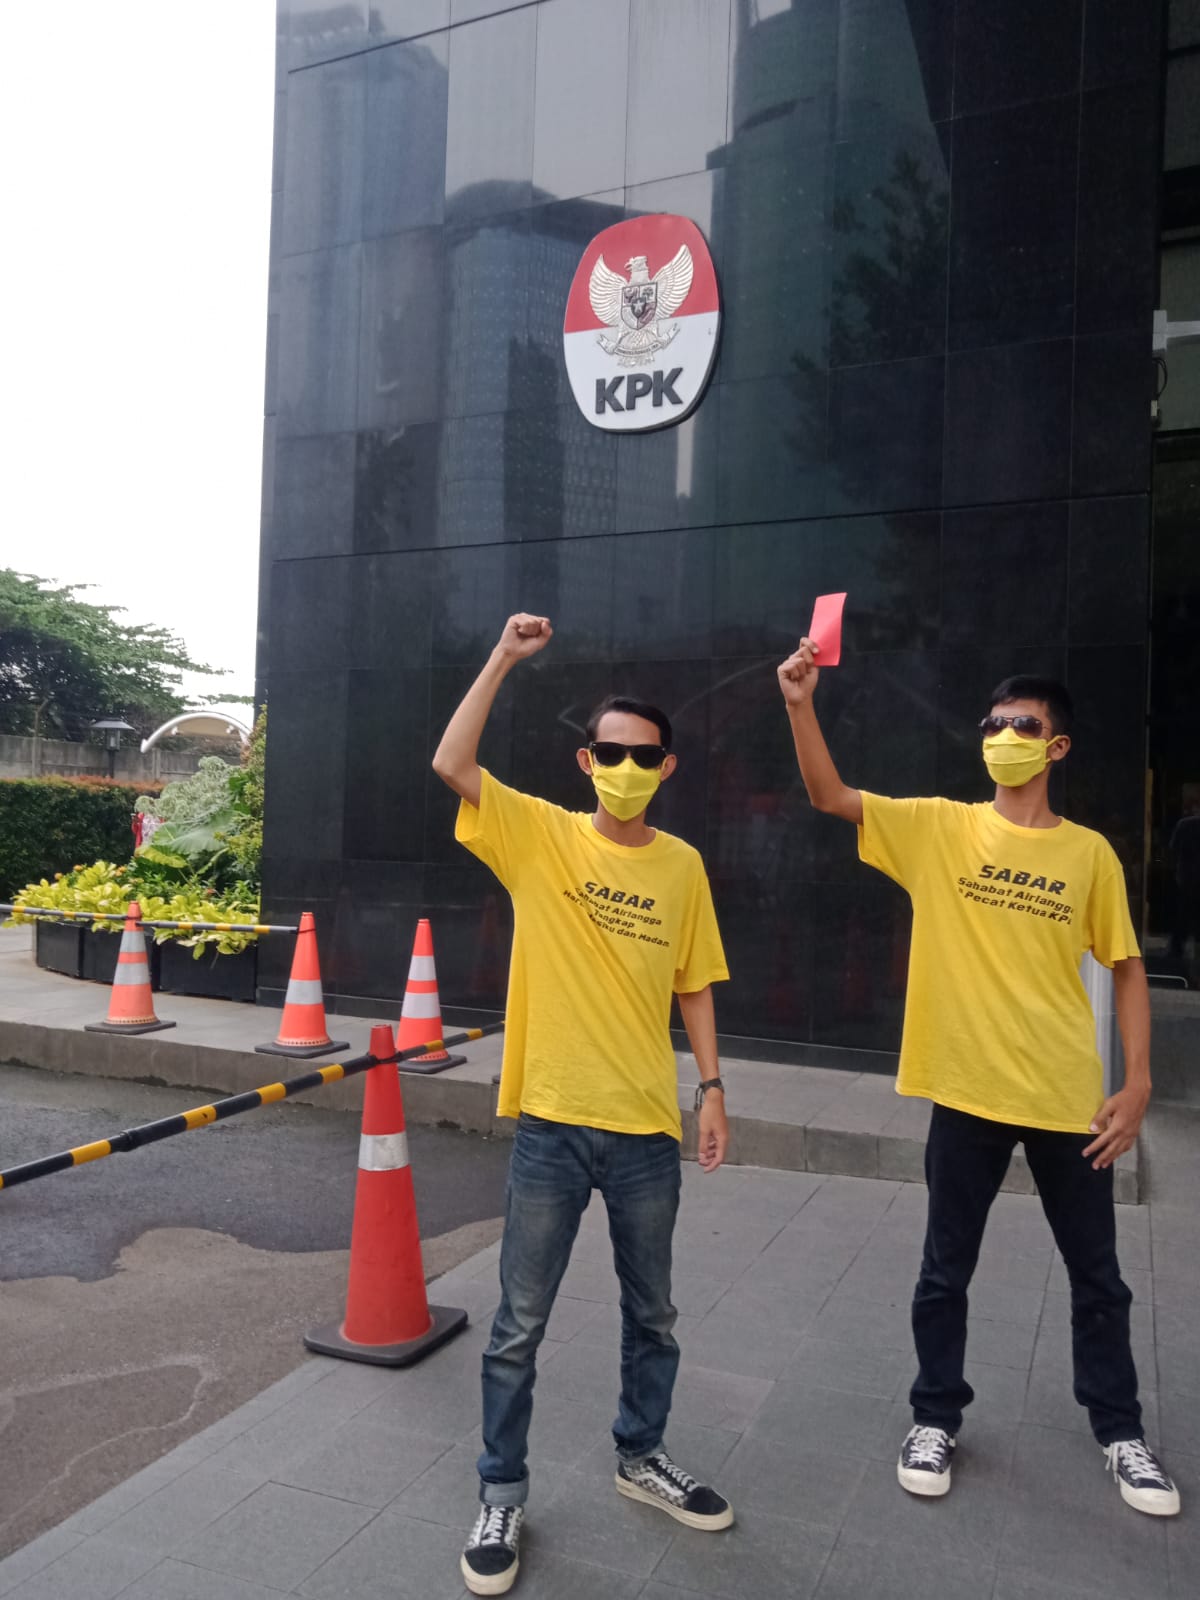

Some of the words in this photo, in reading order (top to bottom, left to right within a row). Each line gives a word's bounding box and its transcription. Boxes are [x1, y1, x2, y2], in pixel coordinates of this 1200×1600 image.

[596, 367, 683, 414] KPK
[958, 877, 1012, 896] Sahabat
[979, 865, 1066, 895] SABAR
[585, 881, 655, 911] SABAR
[964, 891, 1005, 907] Pecat
[1008, 902, 1046, 917] Ketua
[612, 907, 662, 925] Airlangga
[617, 928, 636, 938] dan
